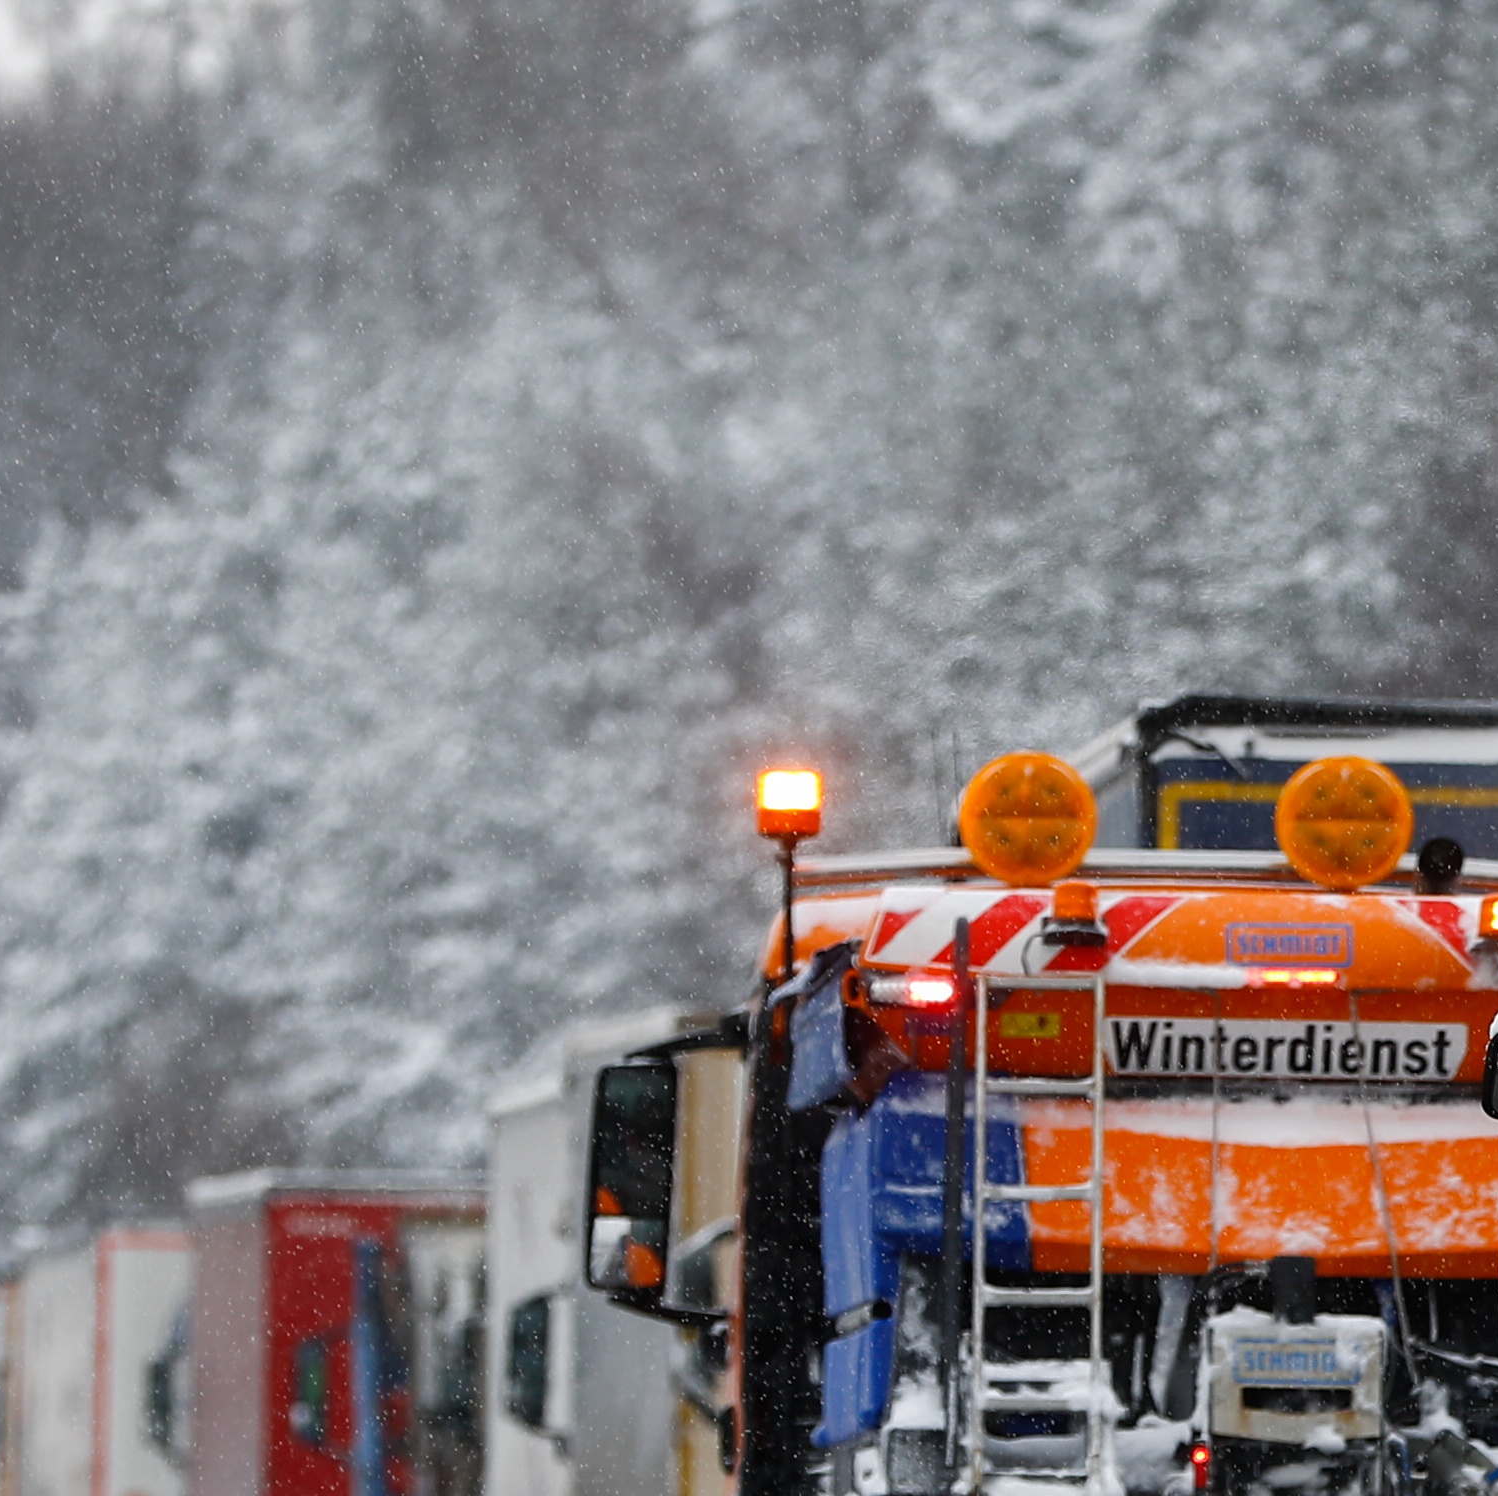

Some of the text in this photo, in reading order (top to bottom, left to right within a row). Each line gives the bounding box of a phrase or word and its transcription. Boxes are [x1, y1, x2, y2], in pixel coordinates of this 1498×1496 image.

[1237, 935, 1340, 955] SCHMIDT
[1110, 1020, 1452, 1076] Winterdienst
[1243, 1351, 1338, 1373] SCHMID
